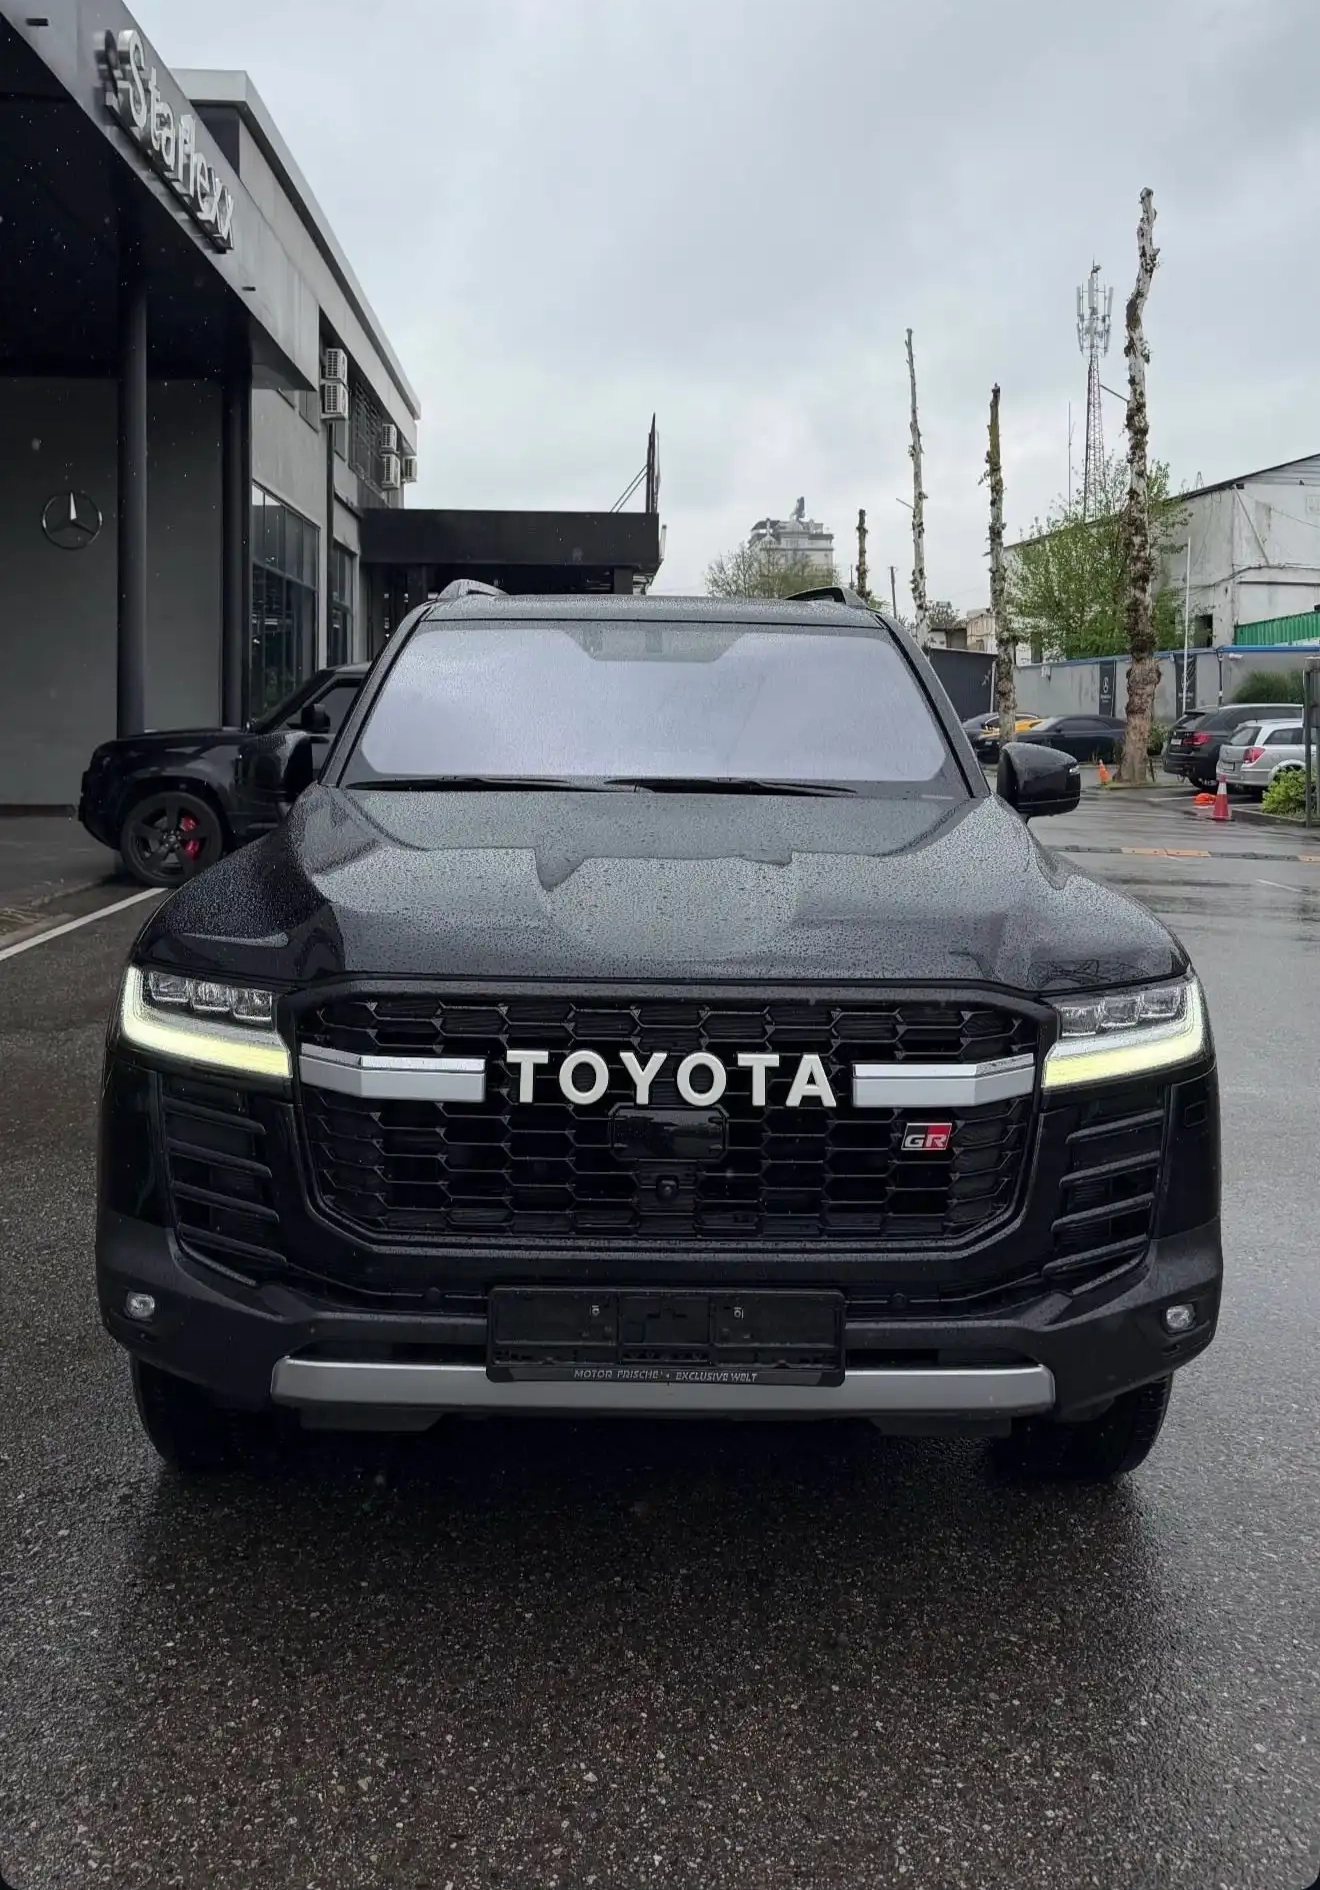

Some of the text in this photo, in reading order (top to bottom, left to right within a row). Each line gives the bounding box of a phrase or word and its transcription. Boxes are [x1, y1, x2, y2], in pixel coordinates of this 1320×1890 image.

[506, 1050, 837, 1107] TOYOTA
[904, 1134, 947, 1148] GR
[574, 1369, 613, 1379] MOTOR
[675, 1371, 729, 1382] EXCLUSIVE
[730, 1373, 758, 1383] WELT
